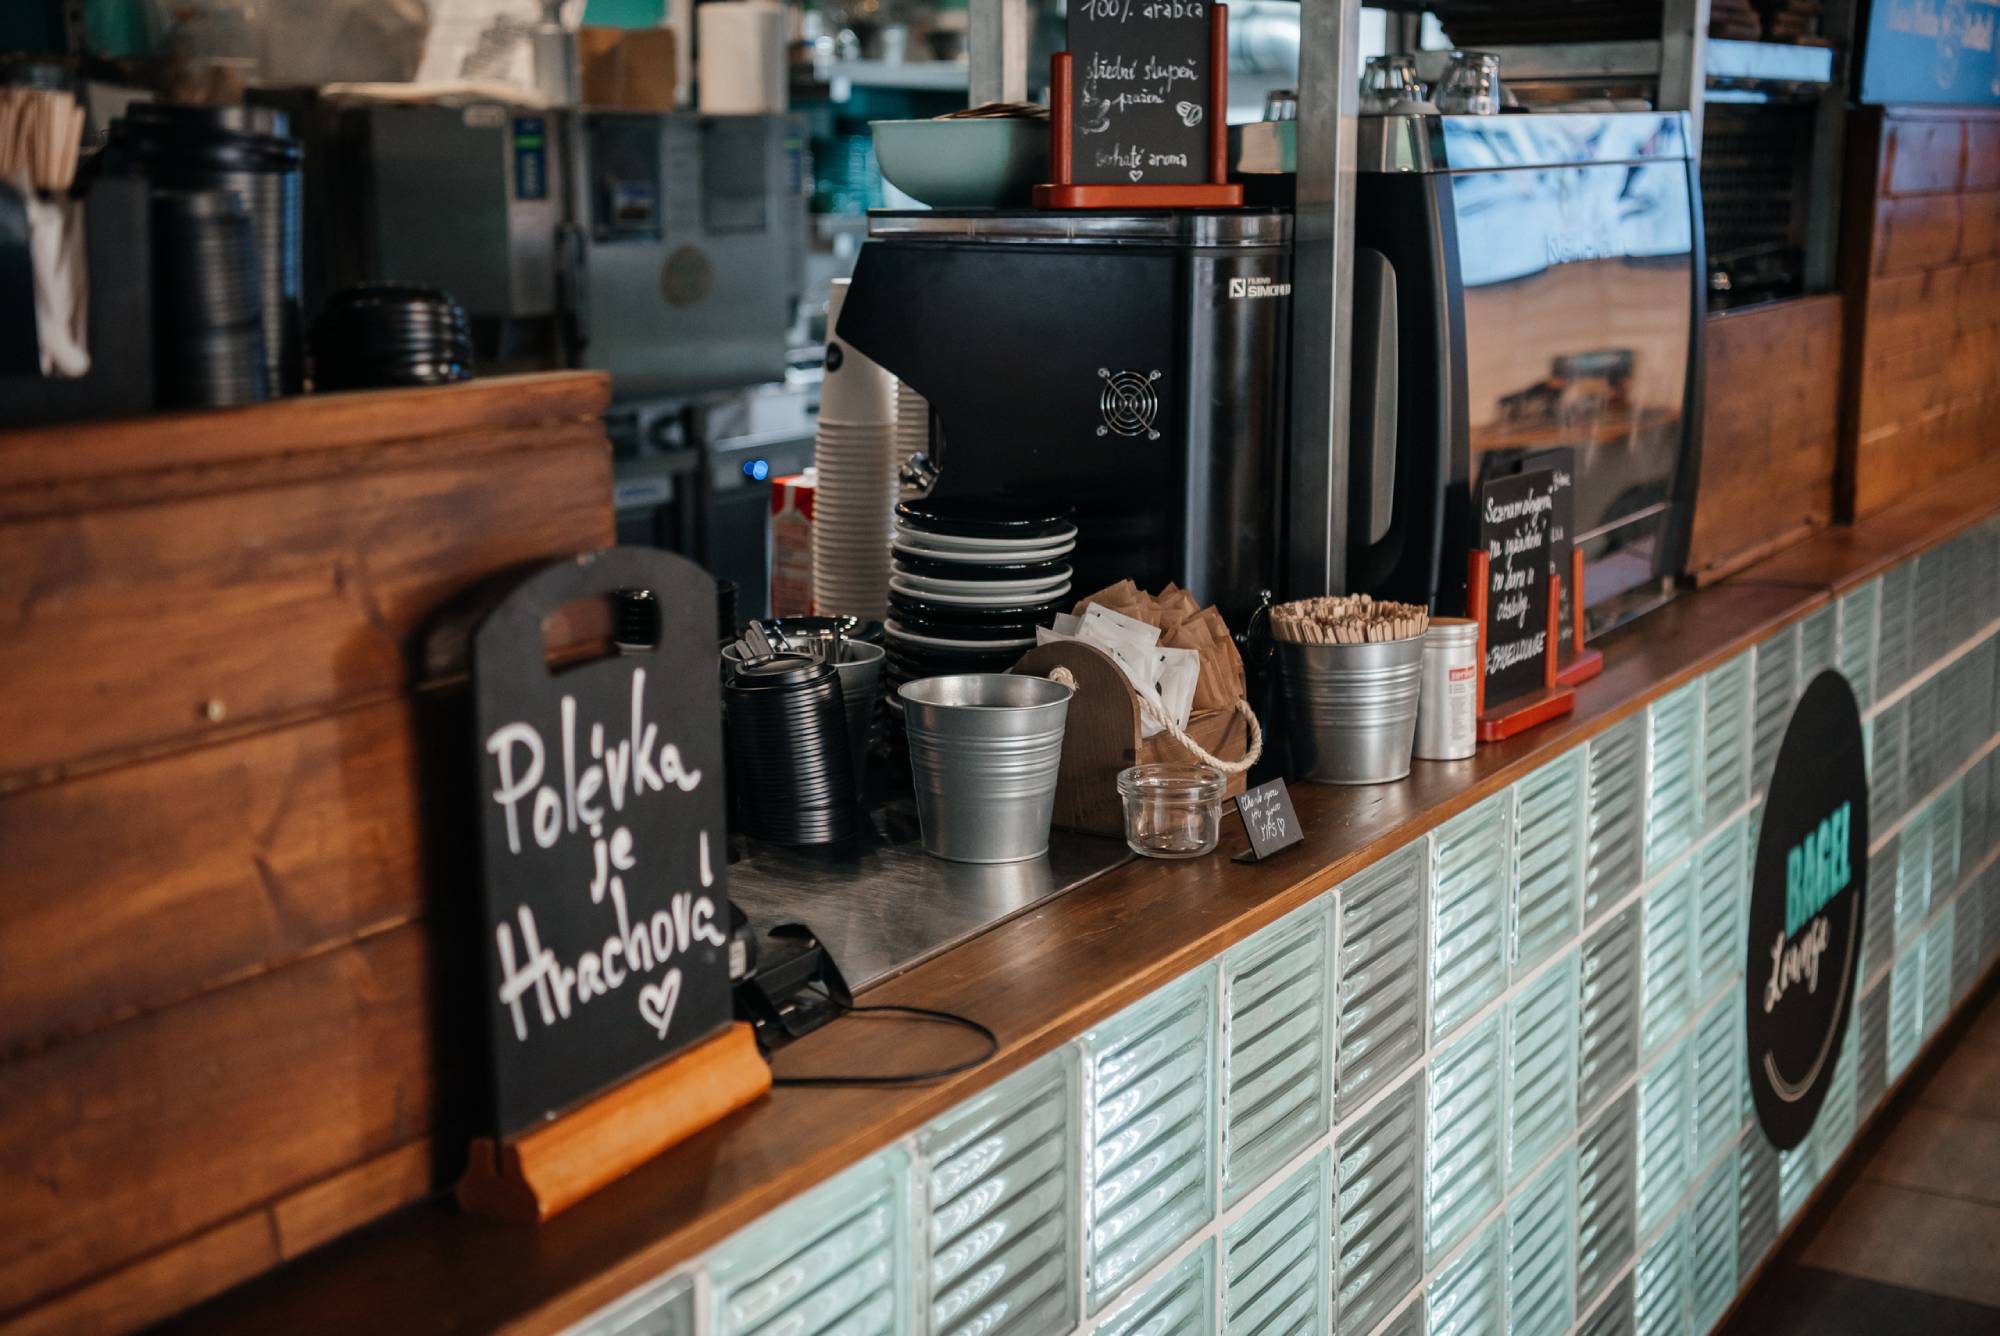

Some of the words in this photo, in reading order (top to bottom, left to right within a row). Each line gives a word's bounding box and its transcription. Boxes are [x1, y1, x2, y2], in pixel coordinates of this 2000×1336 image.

[1143, 0, 1204, 19] arabica
[1149, 153, 1188, 168] aroma
[486, 668, 702, 854] Polévka
[590, 826, 636, 904] je
[1785, 800, 1852, 941] BAGEL
